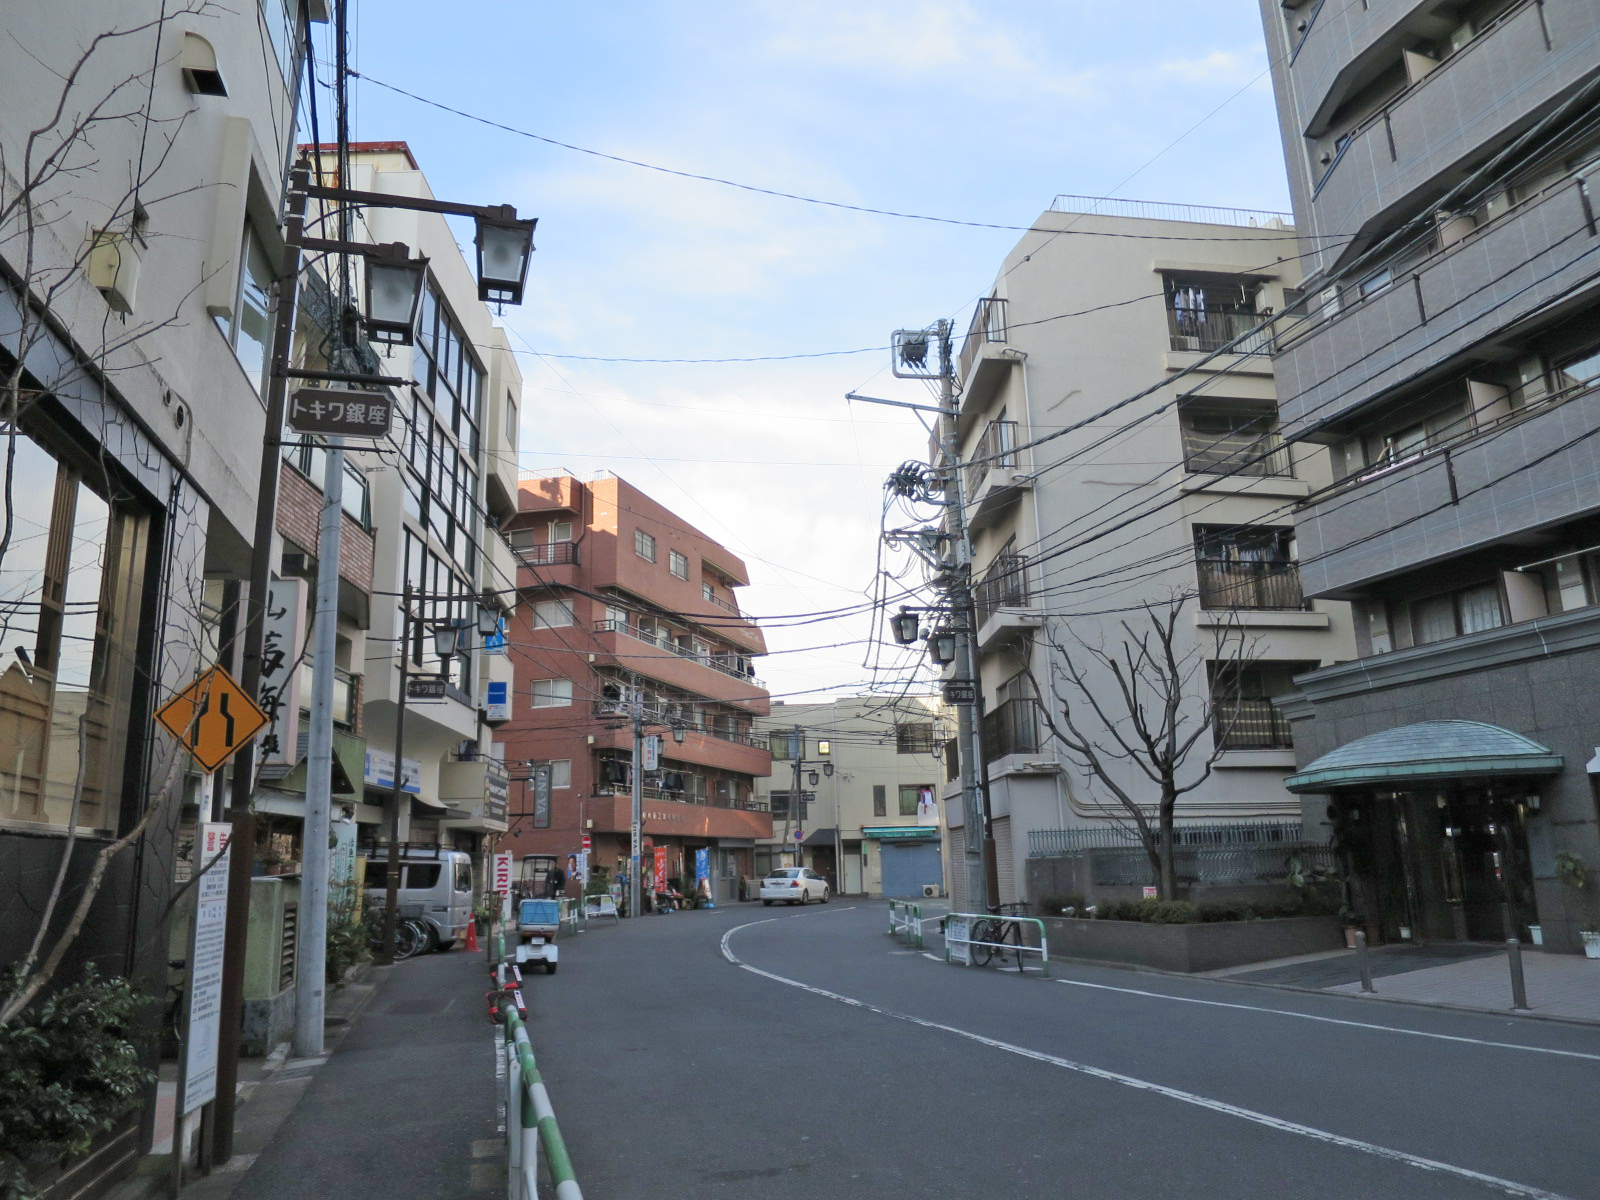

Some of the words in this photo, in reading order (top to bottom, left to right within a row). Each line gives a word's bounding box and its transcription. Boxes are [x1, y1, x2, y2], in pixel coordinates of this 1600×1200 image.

[292, 398, 387, 426] トキワ銀座
[408, 684, 444, 694] トキワ銀座
